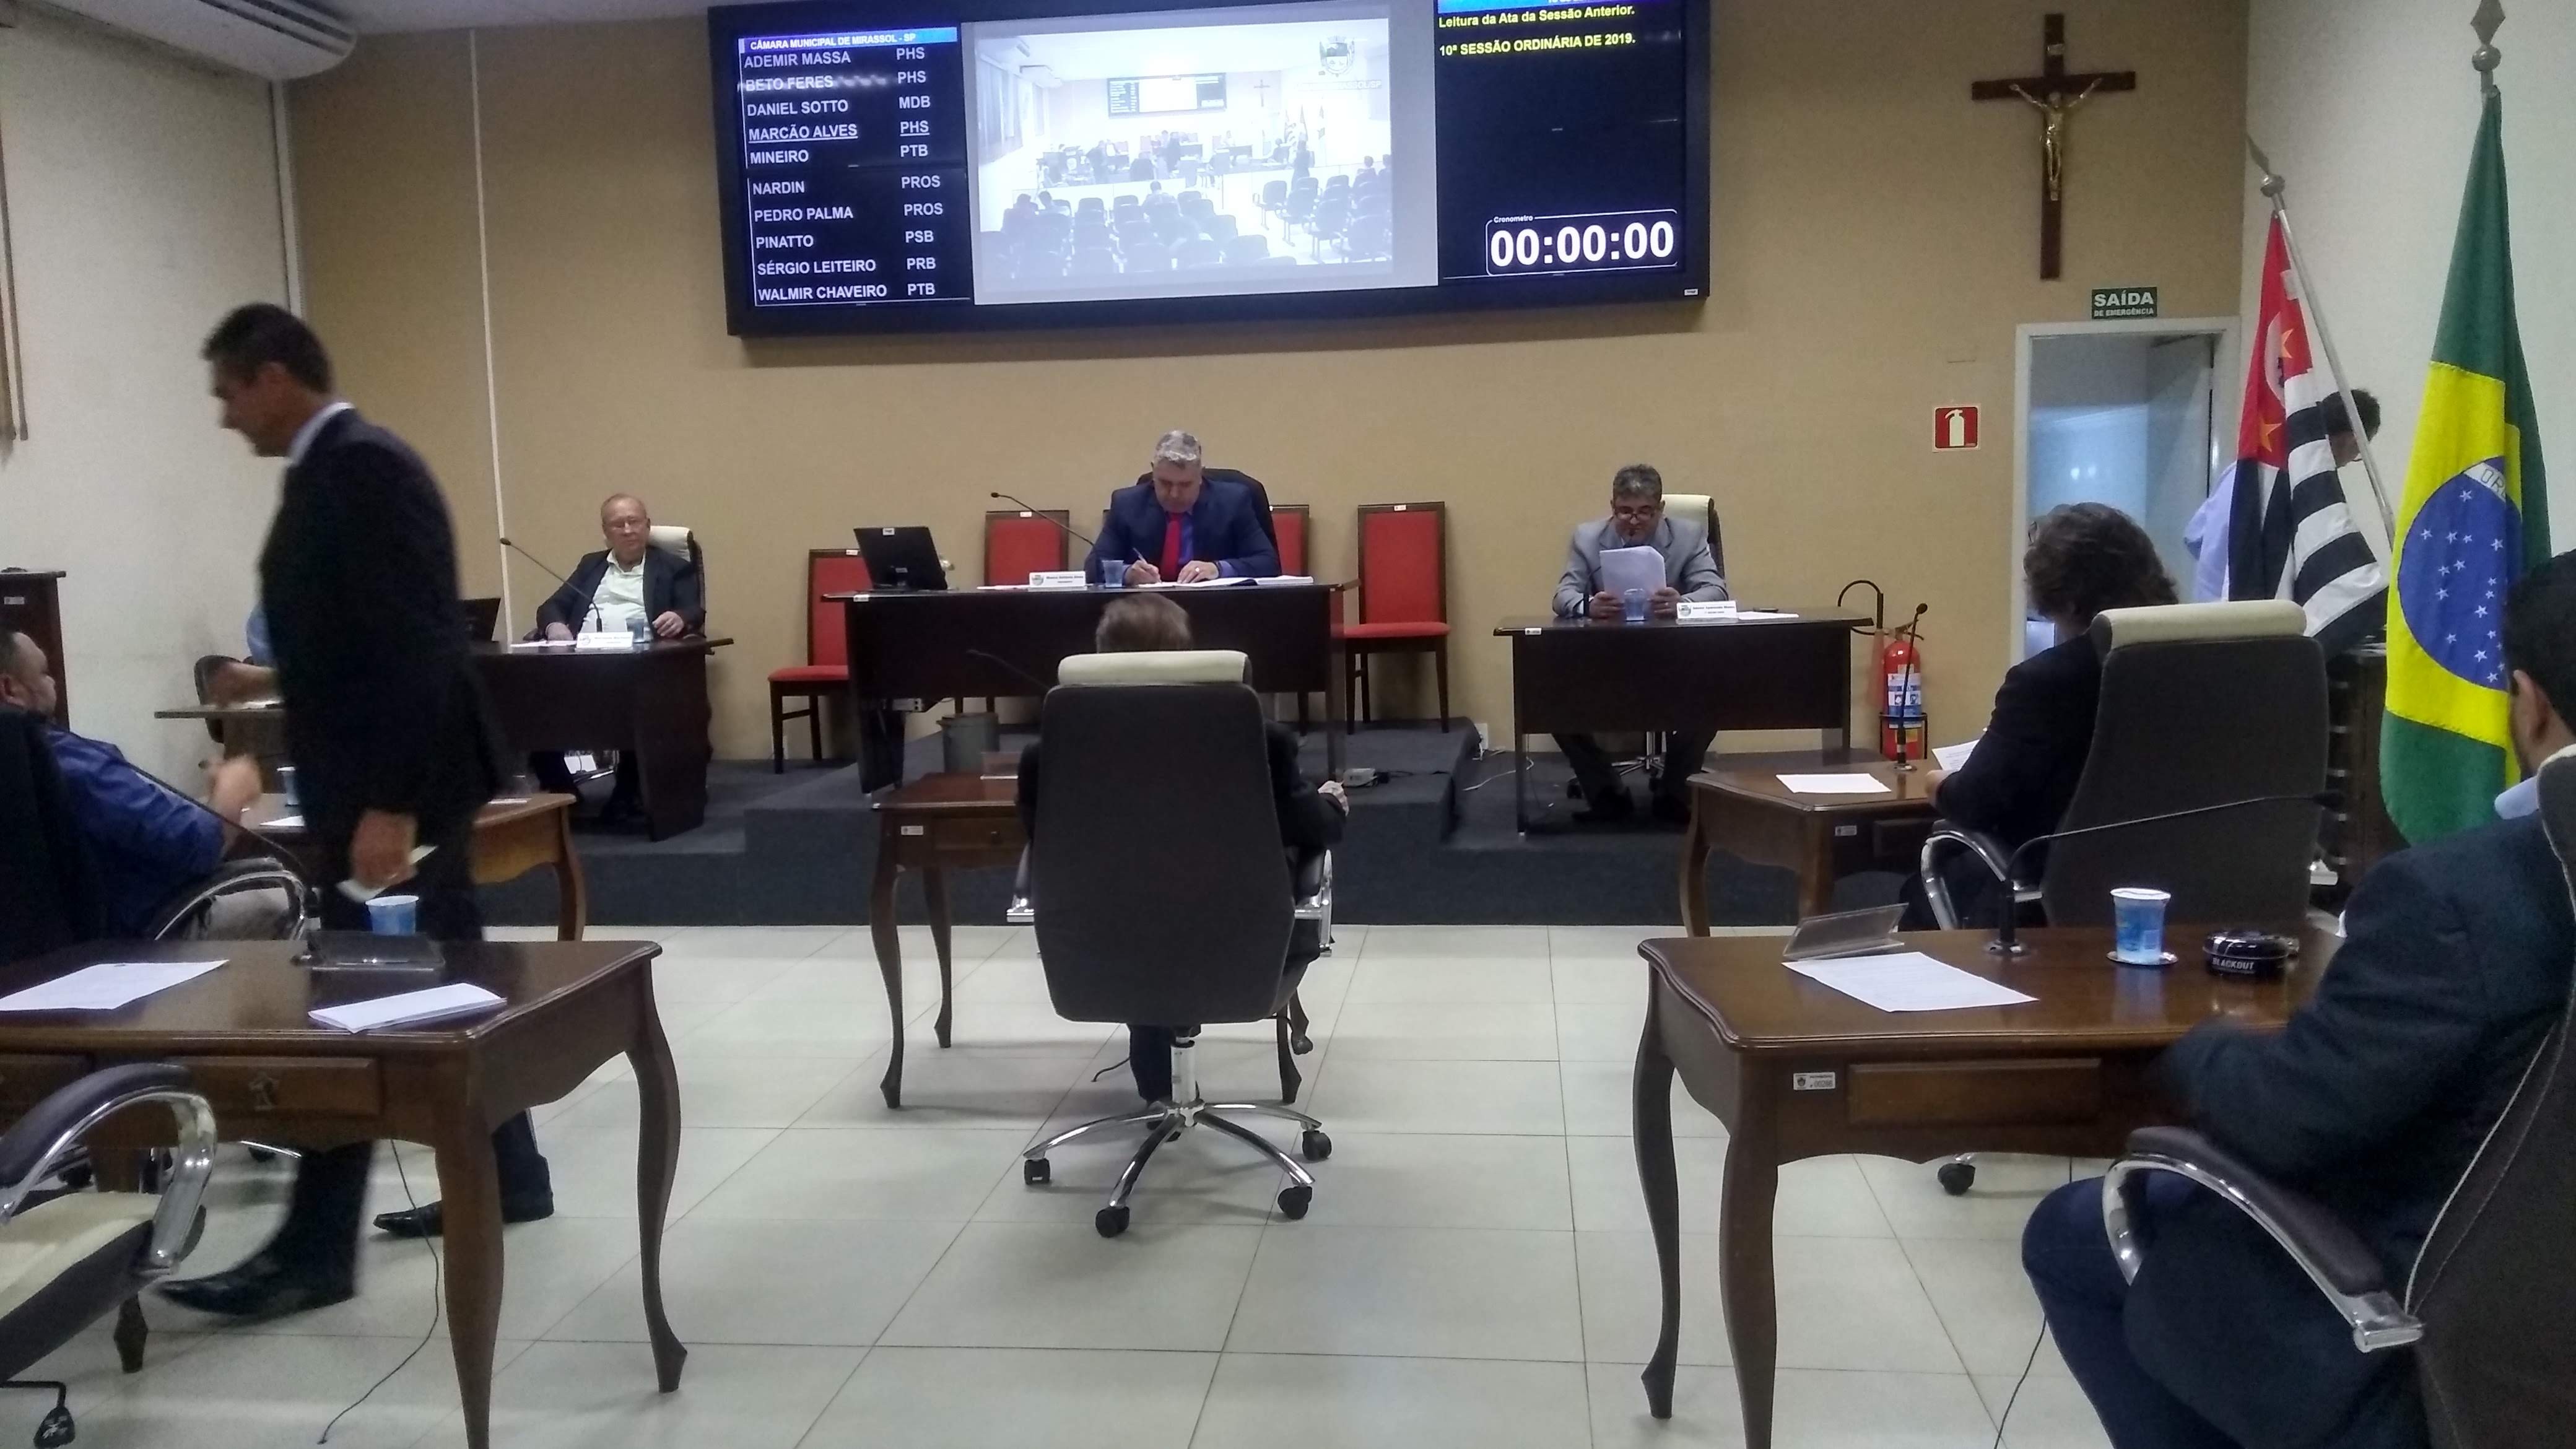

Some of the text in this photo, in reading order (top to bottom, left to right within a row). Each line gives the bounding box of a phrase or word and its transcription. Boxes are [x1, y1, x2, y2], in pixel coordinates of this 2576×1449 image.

[1439, 4, 1635, 27] Leitura da Ata da Sessão Anterior.
[751, 40, 788, 50] CÂMARA
[790, 38, 837, 48] MUNICIPAL
[838, 37, 850, 45] DE
[852, 34, 897, 44] MIRASSOL
[904, 33, 916, 41] SP
[1460, 40, 1511, 54] SESSÃO
[1514, 35, 1582, 51] ORDINÁRIA
[1585, 35, 1602, 46] DE
[1605, 33, 1635, 45] 2019.
[744, 51, 851, 68] ADEMIR MASSA
[897, 47, 925, 60] PHS
[746, 76, 833, 92] BETO FERES
[899, 71, 926, 84] PHS
[747, 99, 848, 116] DANIEL SOTTO
[899, 96, 930, 108] MDB
[749, 124, 857, 141] MARCÃO ALVES
[900, 121, 929, 133] PHS
[751, 150, 809, 163] MINEIRO
[900, 145, 928, 157] PTB
[752, 181, 805, 194] NARDIN
[902, 175, 941, 188] PROS
[754, 206, 853, 222] PEDRO PALMA
[904, 202, 943, 215] PROS
[1494, 215, 1533, 223] Cronometro
[756, 235, 814, 248] PINATTO
[905, 230, 934, 243] PSB
[1491, 221, 1674, 266] 00:00:00
[757, 259, 876, 275] SÉRGIO LEITEIRO
[907, 257, 936, 269] PRB
[759, 284, 887, 300] WALMIR CHAVEIRO
[908, 283, 935, 295] PTB
[2094, 290, 2154, 307] SAÍDA
[2106, 308, 2154, 316] EMERGÊNCIA
[2212, 957, 2254, 970] BLACKOUT
